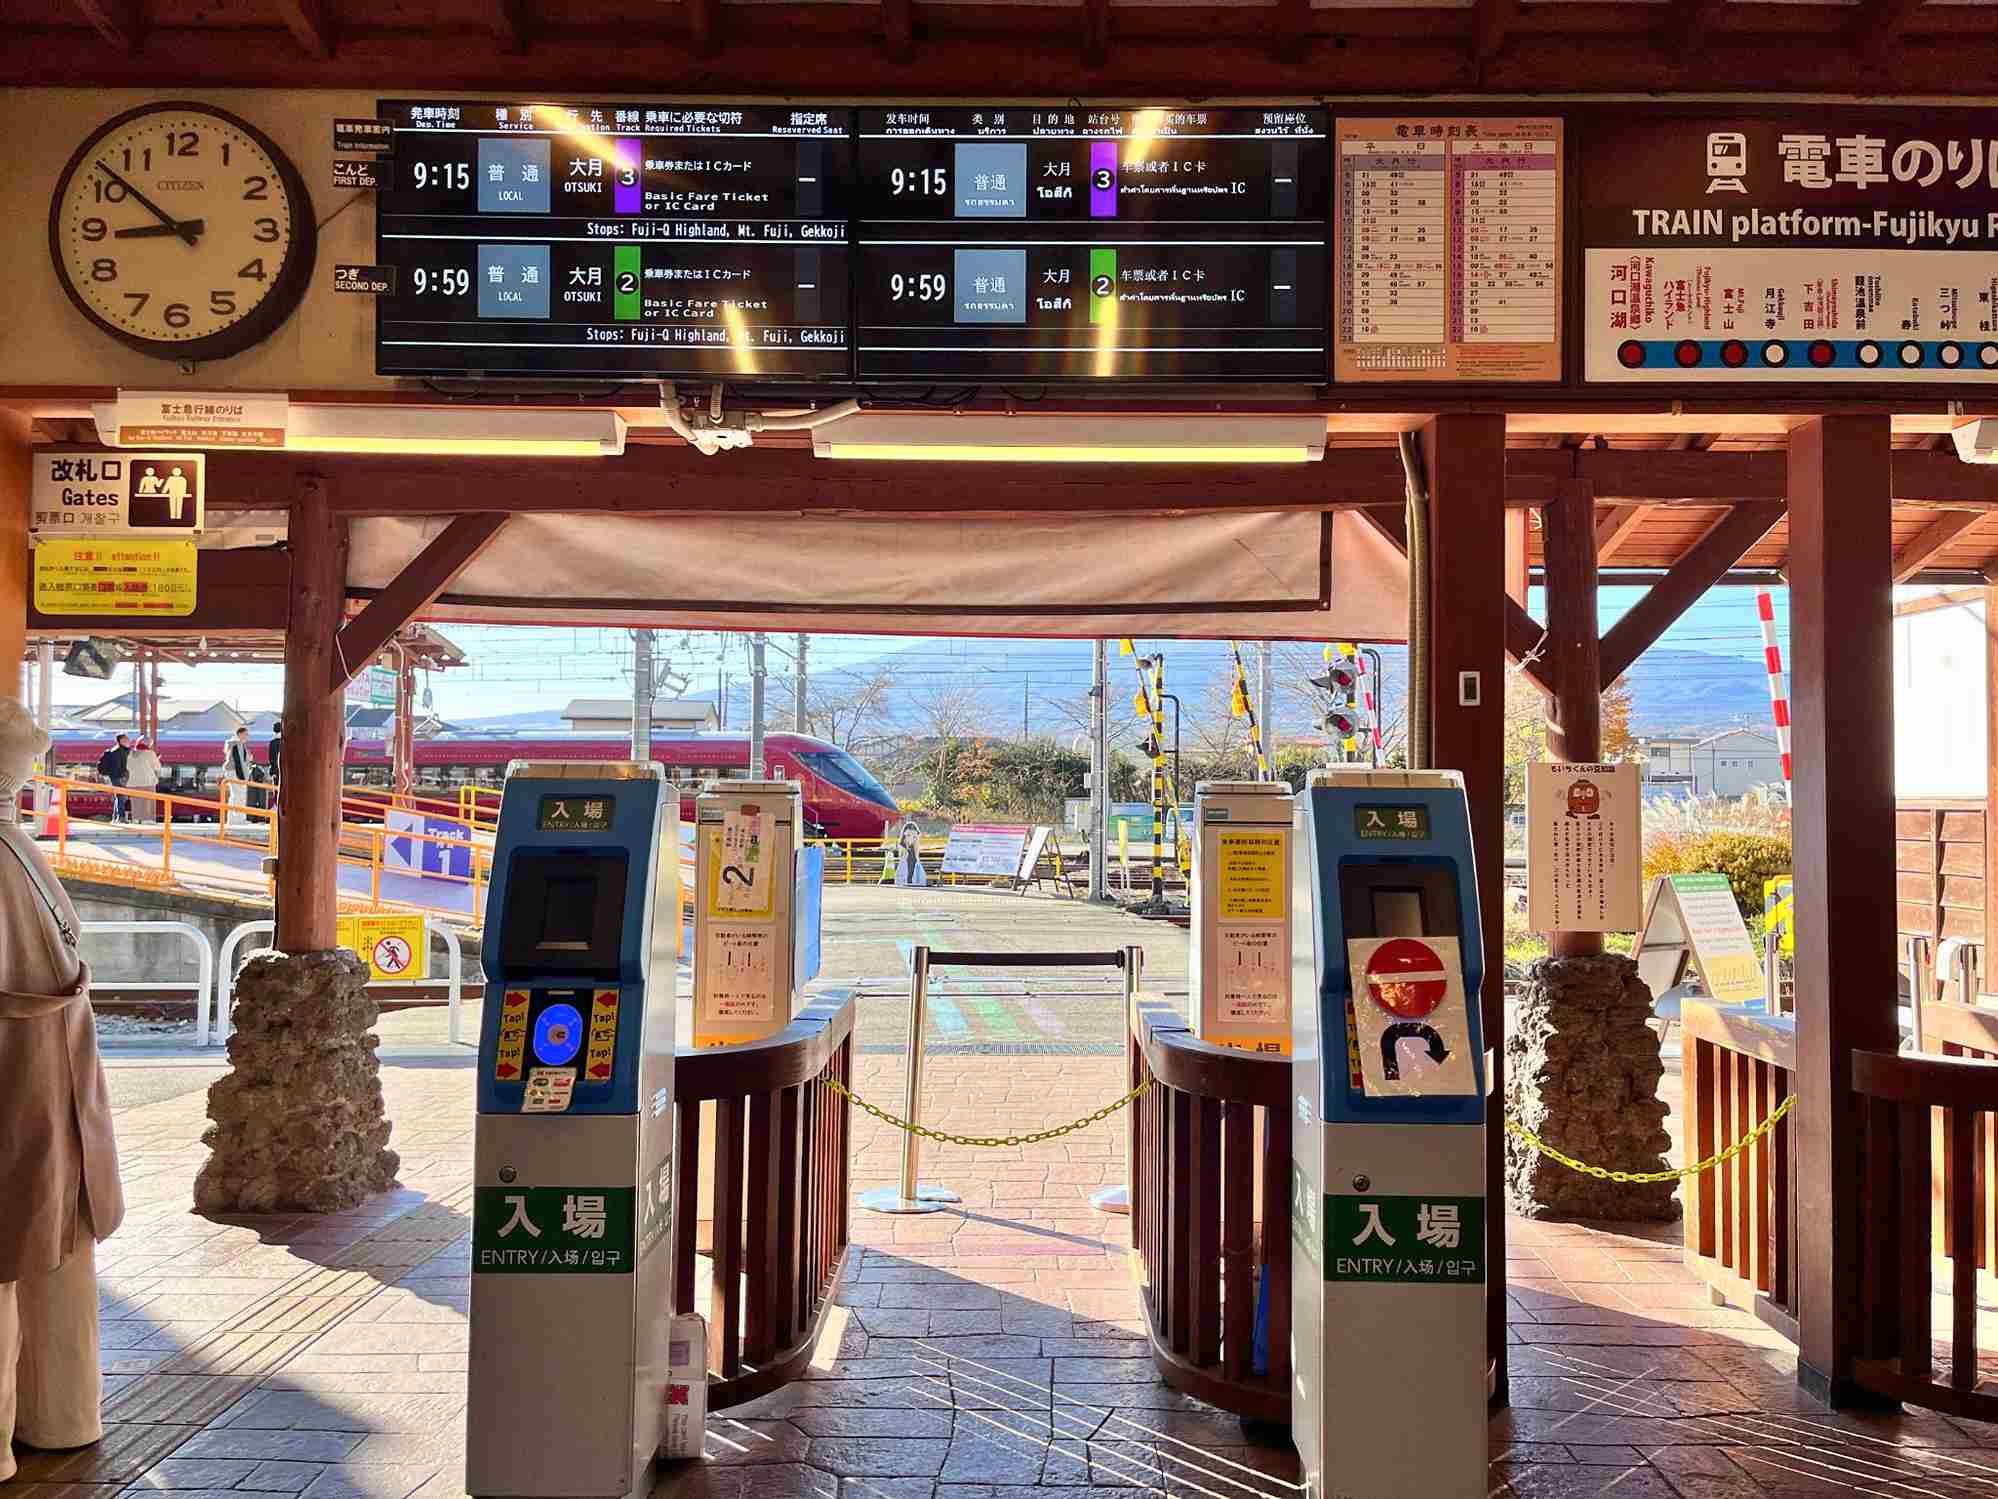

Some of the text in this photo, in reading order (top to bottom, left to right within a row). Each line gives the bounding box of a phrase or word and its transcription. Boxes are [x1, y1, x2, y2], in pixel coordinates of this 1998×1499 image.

[410, 107, 460, 121] 発車時刻
[645, 111, 743, 125] 乗車に必要な切符
[790, 112, 828, 126] 指定席
[616, 123, 640, 132] Track
[166, 132, 199, 157] 12
[123, 148, 151, 171] 11
[221, 143, 230, 166] 1
[1778, 134, 1998, 190] 電車のり
[334, 163, 368, 176] こんど
[413, 162, 470, 190] 9:15
[569, 159, 603, 177] 大月
[620, 168, 635, 186] 3
[1043, 161, 1072, 177] 大月
[243, 176, 268, 200] 2
[334, 176, 378, 186] FIRST DEP.
[564, 182, 602, 193] OTSUKI
[891, 168, 947, 195] 9:15
[1096, 171, 1111, 188] 3
[1231, 182, 1246, 193] IC
[94, 180, 129, 203] 10
[499, 191, 523, 200] LOCAL
[645, 192, 769, 202] Basic Fare Ticket
[645, 202, 715, 211] or IC Card
[81, 218, 107, 241] 9
[255, 218, 279, 242] 3
[587, 223, 845, 239] Stops: Fuji-Q Highland, Mt. Fuji, Gekkoji
[1632, 209, 1722, 236] TRAIN
[91, 258, 118, 282] 8
[238, 258, 267, 281] 4
[336, 268, 360, 280] つぎ
[568, 267, 602, 286] 大月
[1043, 268, 1070, 284] 大月
[336, 280, 369, 290] SECOND
[413, 268, 470, 296] 9:59
[620, 275, 634, 291] 2
[891, 273, 946, 301] 9:59
[1096, 277, 1109, 295] 2
[210, 291, 236, 315] 5
[498, 291, 522, 302] LOCAL
[563, 291, 601, 302] OTSUKI
[644, 299, 768, 309] Basic Fare Ticket
[1231, 289, 1245, 301] IC
[1610, 264, 1627, 329] 河口湖
[124, 293, 149, 316] 7
[644, 309, 714, 318] or IC Card
[1664, 281, 1674, 330] ハイランド
[1723, 288, 1734, 330] 富士山
[1765, 287, 1776, 330] 月江寺
[1803, 283, 1814, 330] 下吉田
[164, 304, 190, 328] 6
[587, 328, 624, 341] Stops:
[631, 329, 669, 343] Fuji-Q
[675, 329, 729, 343] Highland,
[763, 331, 793, 343] Fuji,
[800, 331, 845, 344] Gekkoji
[51, 459, 121, 481] 改札口
[62, 488, 119, 506] Gates
[552, 801, 603, 819] 入場
[1367, 811, 1417, 828] 入場
[428, 828, 465, 841] Track
[439, 849, 450, 876] 1
[504, 1013, 525, 1024] Tap!
[593, 1012, 615, 1024] Tap!
[500, 1047, 521, 1058] Tap!
[590, 1047, 611, 1058] Tap!
[497, 1195, 607, 1239] 入場
[1352, 1203, 1461, 1248] 入場
